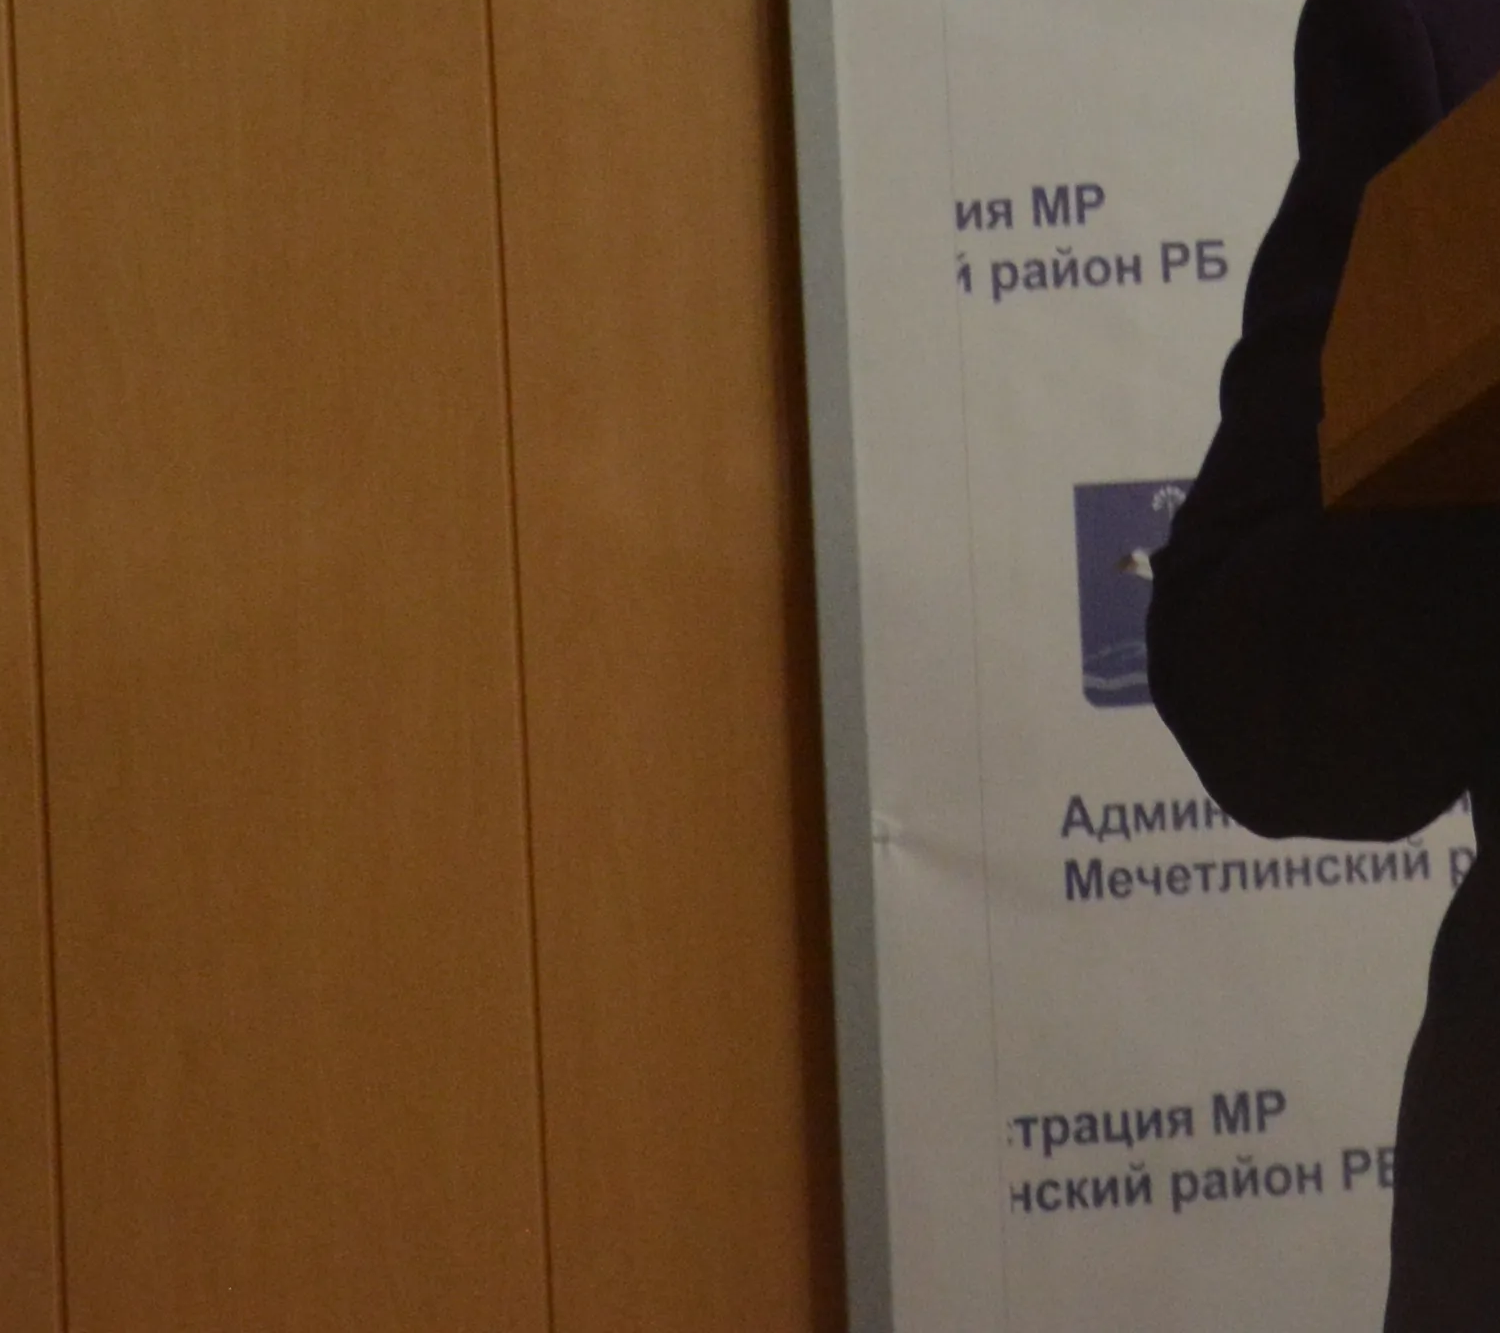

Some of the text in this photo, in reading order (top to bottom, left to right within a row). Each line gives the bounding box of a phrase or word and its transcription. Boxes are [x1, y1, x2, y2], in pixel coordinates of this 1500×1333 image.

[1032, 183, 1106, 228] МР
[990, 249, 1142, 301] район
[1160, 238, 1228, 283] РБ
[1064, 838, 1431, 901] Мечетлинский
[1213, 1089, 1287, 1135] МР
[1171, 1155, 1322, 1211] район
